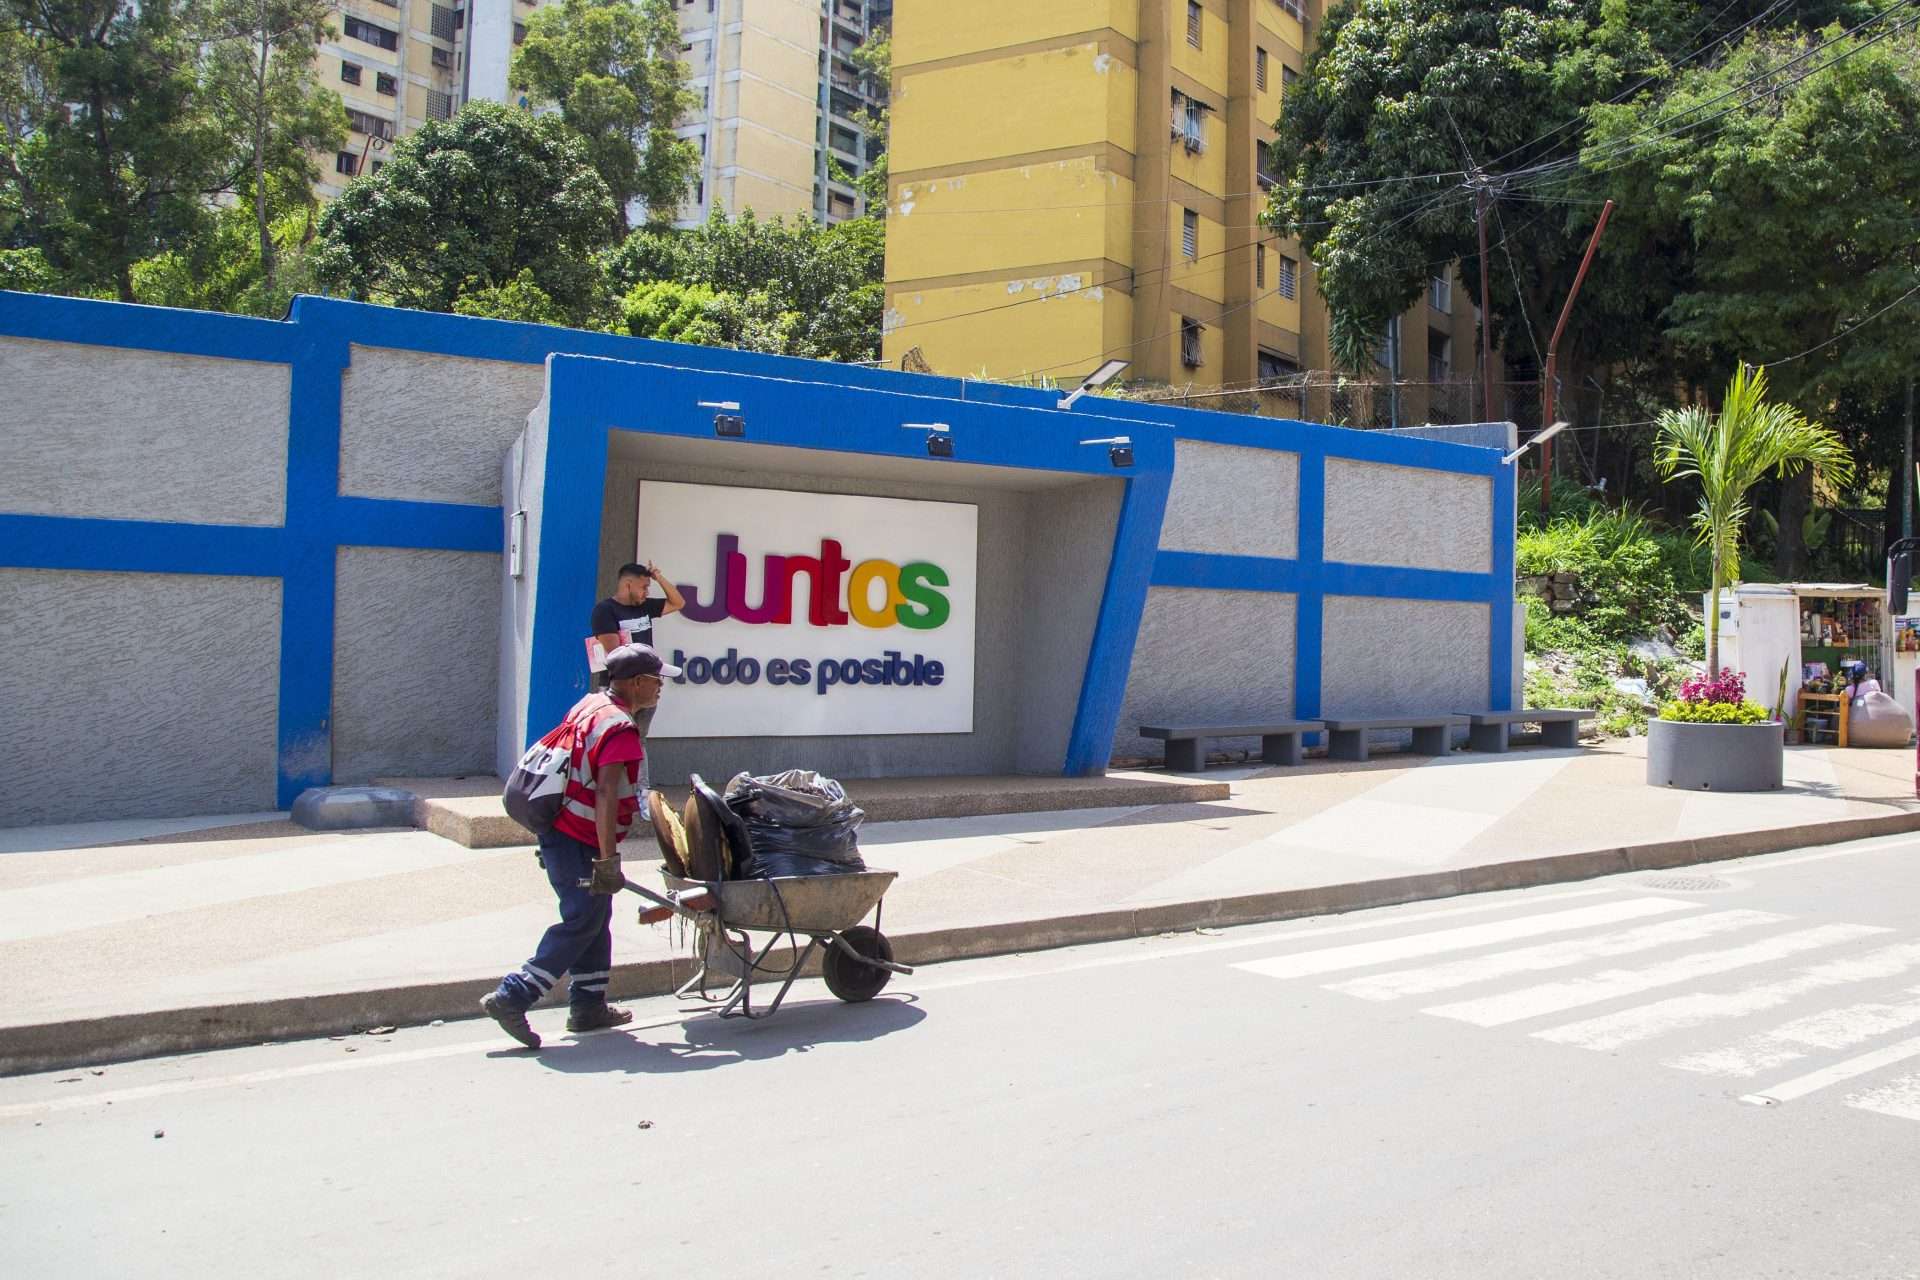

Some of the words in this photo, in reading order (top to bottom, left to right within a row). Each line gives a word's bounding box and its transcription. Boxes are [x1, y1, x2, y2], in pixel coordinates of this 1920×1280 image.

[677, 534, 950, 630] Juntos
[673, 648, 761, 685] todo
[766, 658, 812, 686] es
[817, 650, 945, 695] posible
